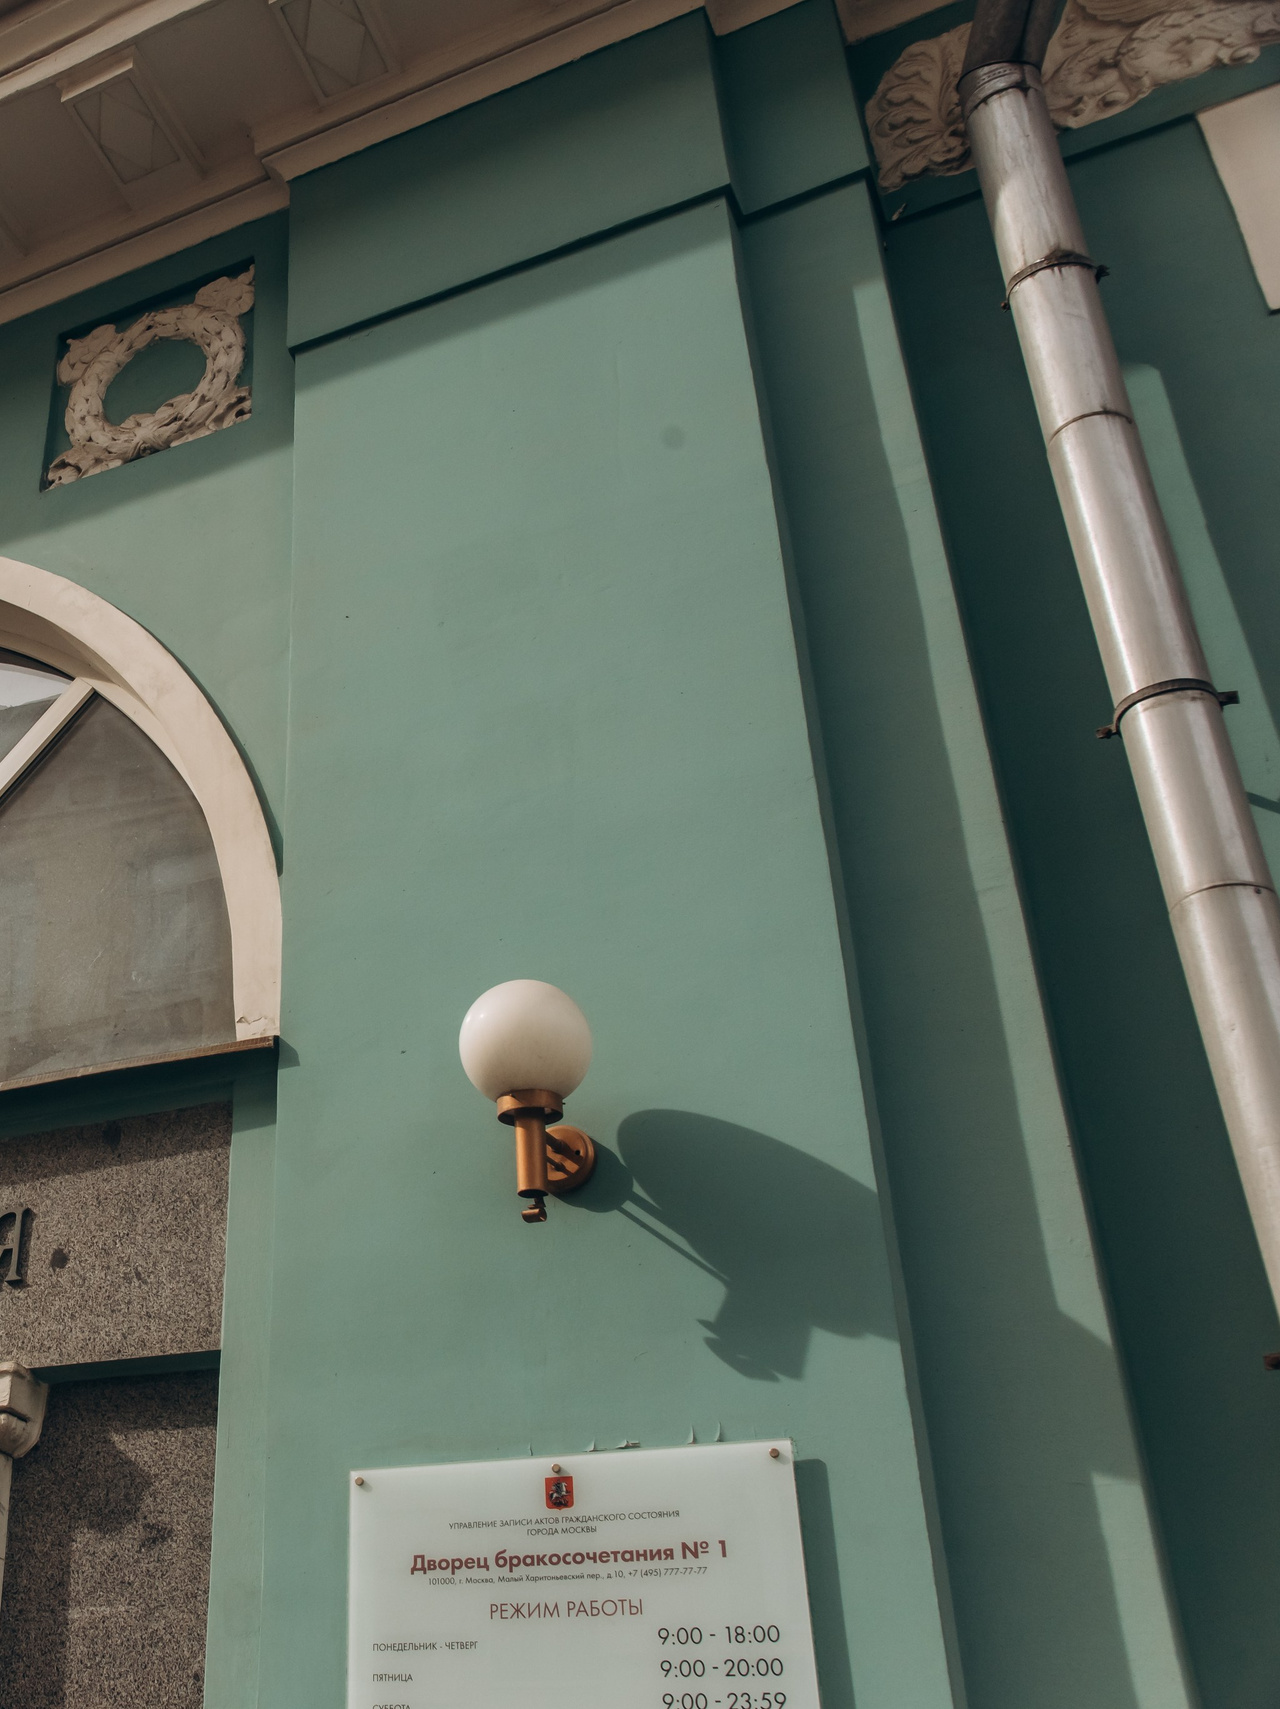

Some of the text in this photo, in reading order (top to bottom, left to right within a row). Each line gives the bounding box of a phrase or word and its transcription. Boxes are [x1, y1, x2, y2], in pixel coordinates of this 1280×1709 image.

[449, 1510, 680, 1530] УПРАВЛЕНИЕ ЗАПИСИ АКТОВ ГРАЖДАНСКОГО СОСТОЯНИЯ
[527, 1525, 597, 1536] ГОРОДА МОСКВЫ
[410, 1554, 490, 1575] Дворец
[495, 1547, 674, 1573] бракосочетания
[718, 1540, 727, 1558] 1
[428, 1577, 456, 1586] 101000,
[465, 1576, 495, 1585] Москва,
[498, 1574, 523, 1583] Малый
[525, 1572, 585, 1584] Харитоньевский
[628, 1570, 638, 1578] +7
[640, 1568, 662, 1578] (495)
[663, 1566, 708, 1576] 777-77-77
[489, 1598, 643, 1620] РЕЖИМ РАБОТЫ
[658, 1627, 702, 1645] 9:00
[725, 1625, 780, 1643] 18:00
[372, 1642, 437, 1652] ПОНЕДЕЛЬНИК
[445, 1641, 478, 1650] ЧЕТВЕРГ
[660, 1659, 705, 1677] 9:00
[724, 1658, 783, 1677] 20:00
[372, 1673, 413, 1683] ПЯТНИЦА
[662, 1692, 708, 1709] 9:00
[727, 1692, 787, 1709] 23:59
